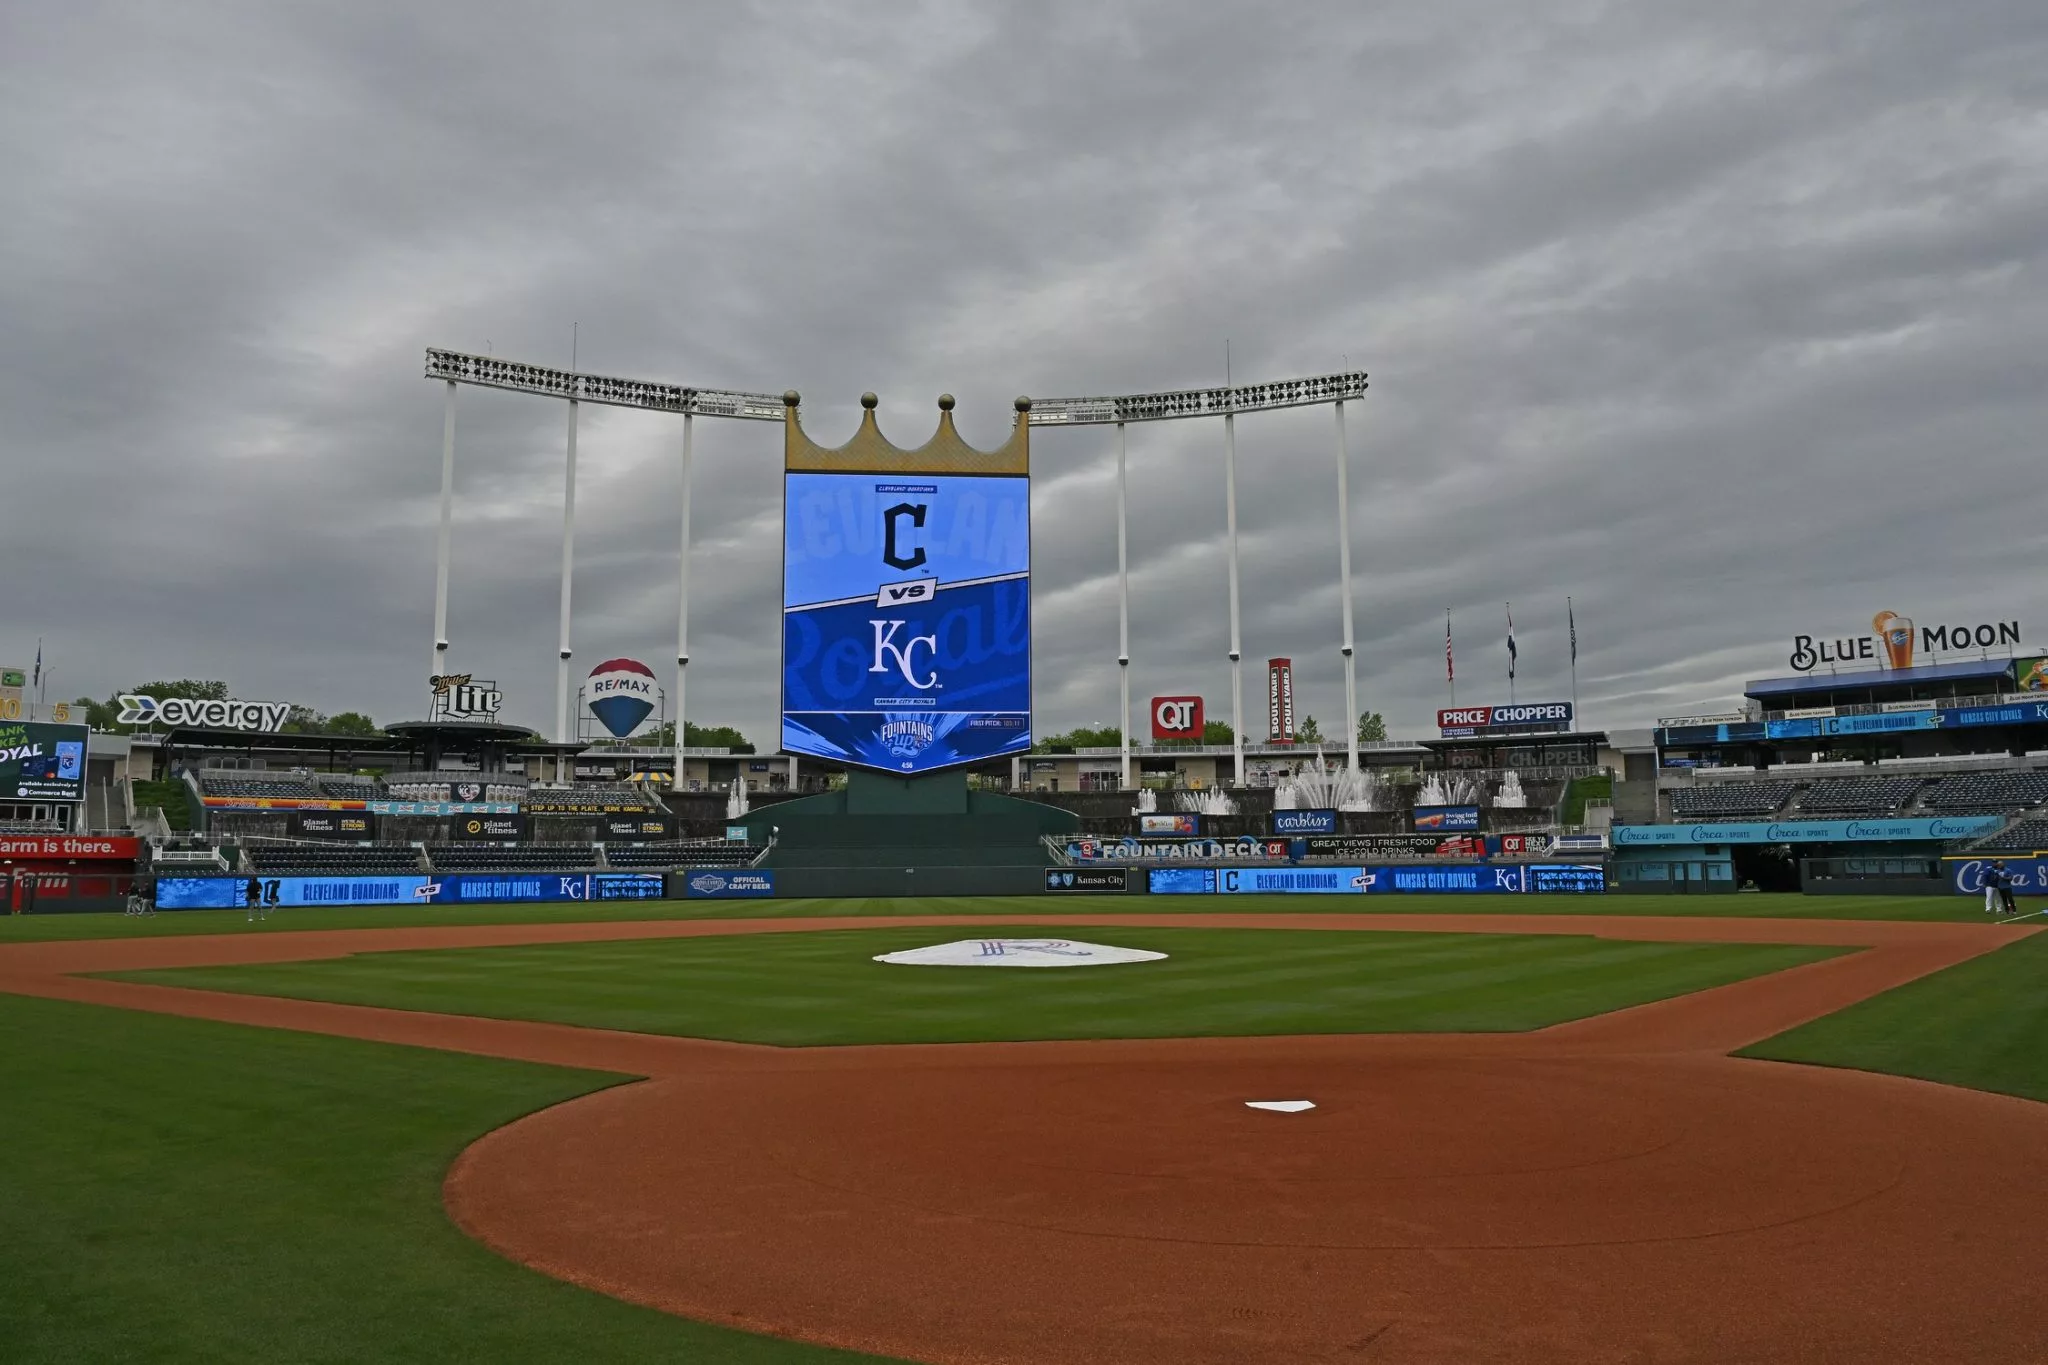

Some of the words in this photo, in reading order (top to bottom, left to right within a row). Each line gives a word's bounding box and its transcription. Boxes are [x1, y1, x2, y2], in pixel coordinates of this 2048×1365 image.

[883, 502, 927, 571] C
[889, 584, 926, 601] VS
[868, 619, 937, 689] KC
[1790, 635, 1874, 671] BLUE
[1922, 621, 2020, 653] MOON
[430, 673, 472, 694] Miller
[594, 679, 650, 695] RE/MAX
[443, 684, 503, 719] Lite
[1271, 672, 1279, 734] BOULEVARD
[1283, 671, 1293, 734] BOULEVARD
[53, 703, 71, 723] 5
[160, 699, 291, 732] evergy
[1156, 701, 1195, 732] QT
[1443, 710, 1486, 724] PRICE
[1494, 704, 1567, 722] CHOPPER
[882, 721, 933, 742] FOUNTAINS
[1829, 719, 1840, 733] C
[20, 735, 29, 745] A
[28, 789, 60, 797] Commerce
[61, 790, 77, 798] Bank
[303, 819, 328, 827] planet
[484, 820, 512, 830] planet
[610, 822, 632, 830] planet
[1277, 812, 1331, 829] carbliss
[1929, 819, 1967, 837] Circa
[487, 826, 518, 834] fitness
[1619, 827, 1650, 843] Circa
[1691, 825, 1725, 842] Circa
[1766, 824, 1800, 841] Circa
[1845, 822, 1881, 839] Circa
[1888, 828, 1911, 836] SPORTS
[0, 838, 38, 853] arm
[43, 838, 58, 853] is
[63, 838, 116, 853] there.
[1103, 843, 1204, 859] FOUNTAIN
[1210, 842, 1263, 858] DECK
[1269, 843, 1282, 854] QT
[1335, 847, 1379, 855] ICE-COLD
[1381, 847, 1415, 855] DRINKS
[1342, 839, 1371, 847] VIEWS
[1410, 838, 1437, 846] FOOD
[1504, 838, 1520, 851] QT
[1077, 875, 1106, 884] Kansas
[1107, 875, 1124, 886] City
[1226, 870, 1239, 892] C
[1256, 874, 1295, 889] CLEVELAND
[1296, 874, 1338, 889] GUARDIANS
[1395, 873, 1427, 888] KANSAS
[1428, 873, 1446, 888] CITY
[1451, 873, 1477, 888] ROYALS
[1494, 868, 1517, 892] KC
[1956, 860, 2031, 893] Cia
[2037, 865, 2048, 887] S
[303, 883, 349, 901] CLEVELAND
[351, 883, 400, 900] GUARDIANS
[419, 886, 437, 894] VS
[460, 882, 491, 898] KANSAS
[494, 882, 510, 898] CITY
[512, 881, 540, 897] ROYALS
[560, 877, 582, 899] KC
